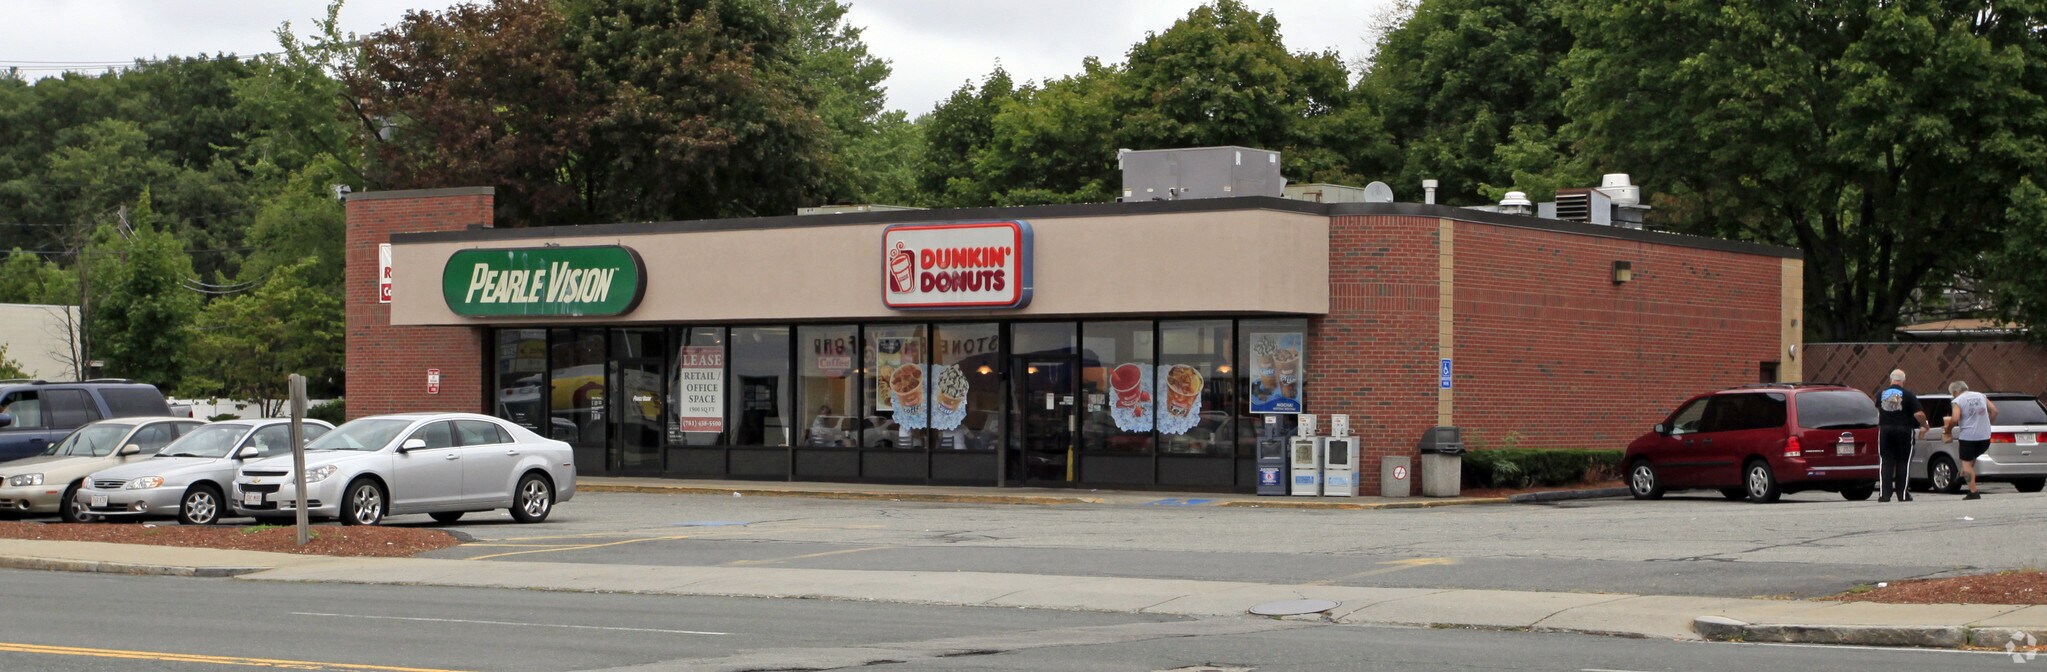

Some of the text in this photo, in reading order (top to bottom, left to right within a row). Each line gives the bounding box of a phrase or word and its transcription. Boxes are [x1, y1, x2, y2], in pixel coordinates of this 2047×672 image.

[920, 246, 1011, 269] DUNKIN'
[464, 261, 615, 304] PEARLE VISION
[920, 269, 1006, 293] DONUTS
[683, 354, 722, 366] LEASE
[684, 371, 715, 381] RETAIL
[686, 383, 718, 393] OFFICE
[688, 394, 716, 404] SPACE
